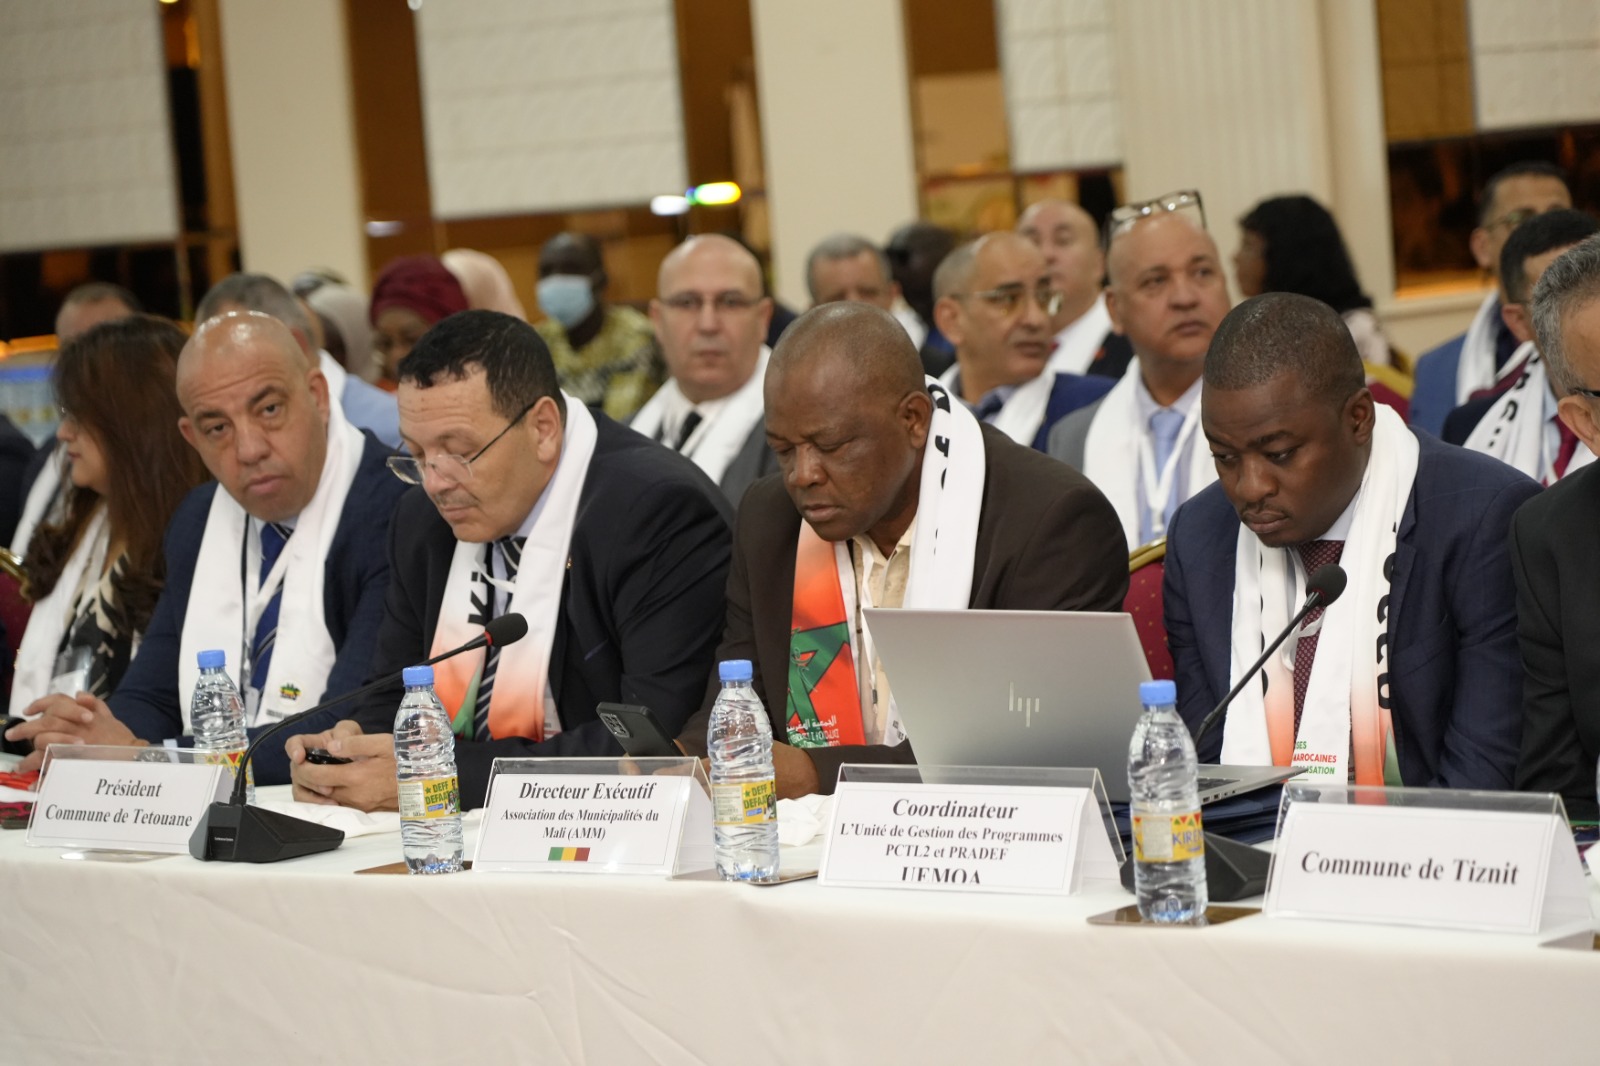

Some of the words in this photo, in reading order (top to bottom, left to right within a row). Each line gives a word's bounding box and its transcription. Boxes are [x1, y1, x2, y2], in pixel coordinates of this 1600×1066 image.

[95, 778, 162, 798] Président
[432, 781, 449, 793] DEFF
[518, 782, 590, 800] Directeur
[593, 781, 659, 801] Exécutif
[751, 784, 767, 797] DEFF
[45, 804, 111, 823] Commune
[112, 808, 129, 824] de
[133, 808, 193, 827] Tetouane
[500, 808, 556, 821] Association
[557, 809, 574, 821] des
[578, 809, 644, 824] Municipalités
[645, 809, 659, 822] du
[892, 798, 1019, 819] Coordinateur
[542, 826, 567, 839] Mali
[566, 826, 607, 841] (AMM)
[840, 822, 887, 837] L'Unité
[889, 824, 905, 837] de
[907, 825, 954, 839] Gestion
[957, 826, 978, 840] des
[982, 827, 1063, 843] Programmes
[885, 843, 931, 858] PCTL2
[933, 847, 945, 858] et
[948, 845, 1009, 862] PRADEF
[1301, 851, 1412, 879] Commune
[1418, 857, 1444, 881] de
[1453, 858, 1519, 885] Tiznit
